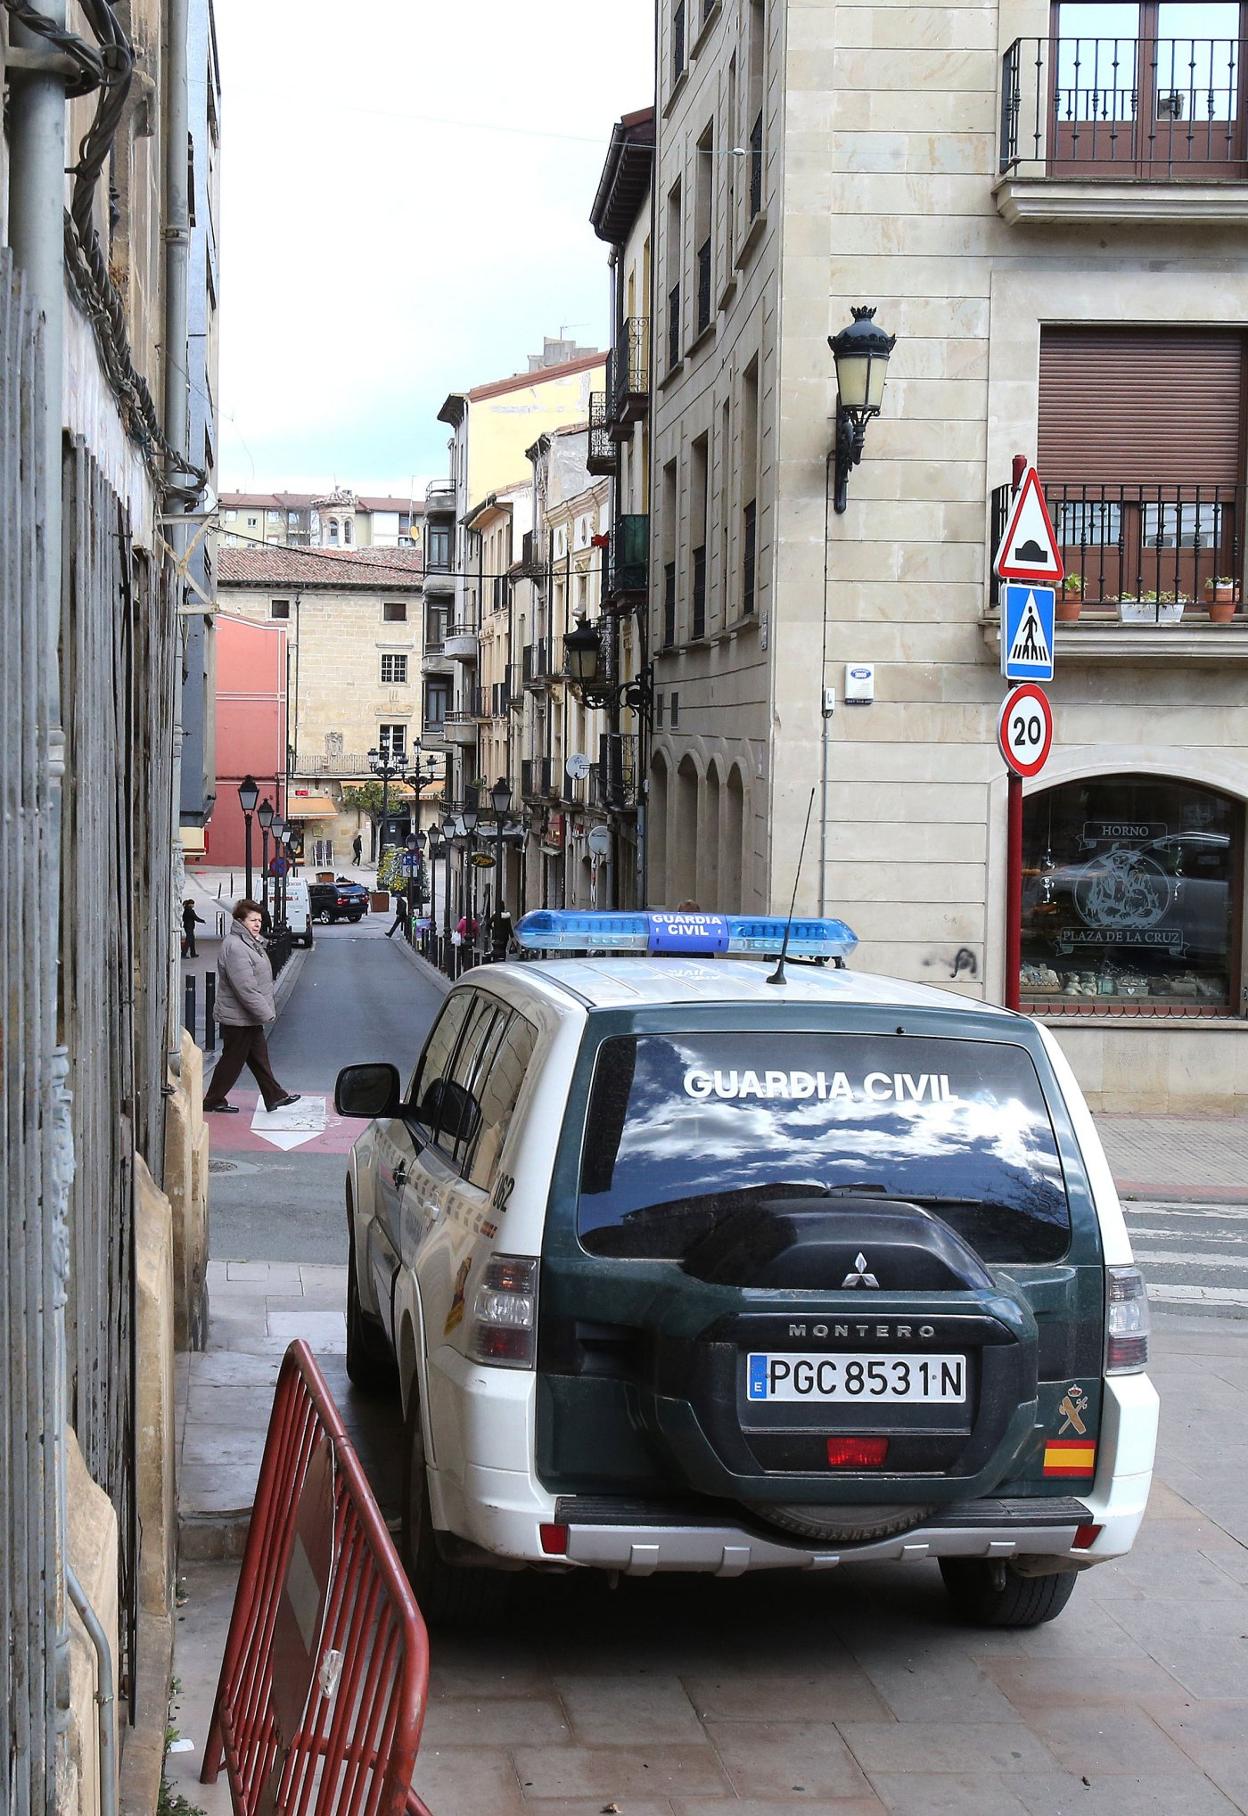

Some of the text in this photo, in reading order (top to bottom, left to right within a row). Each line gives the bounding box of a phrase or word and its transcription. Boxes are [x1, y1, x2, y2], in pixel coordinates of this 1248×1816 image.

[1013, 716, 1041, 746] 20
[1102, 825, 1149, 836] HORNO
[652, 914, 722, 924] GUARDIA
[668, 925, 709, 936] CIVIL
[1062, 931, 1180, 943] PLAZA DE LA CRUZ
[683, 1070, 959, 1101] GUARDIA CIVIL
[789, 1323, 936, 1338] MONTERO
[753, 1381, 763, 1393] E
